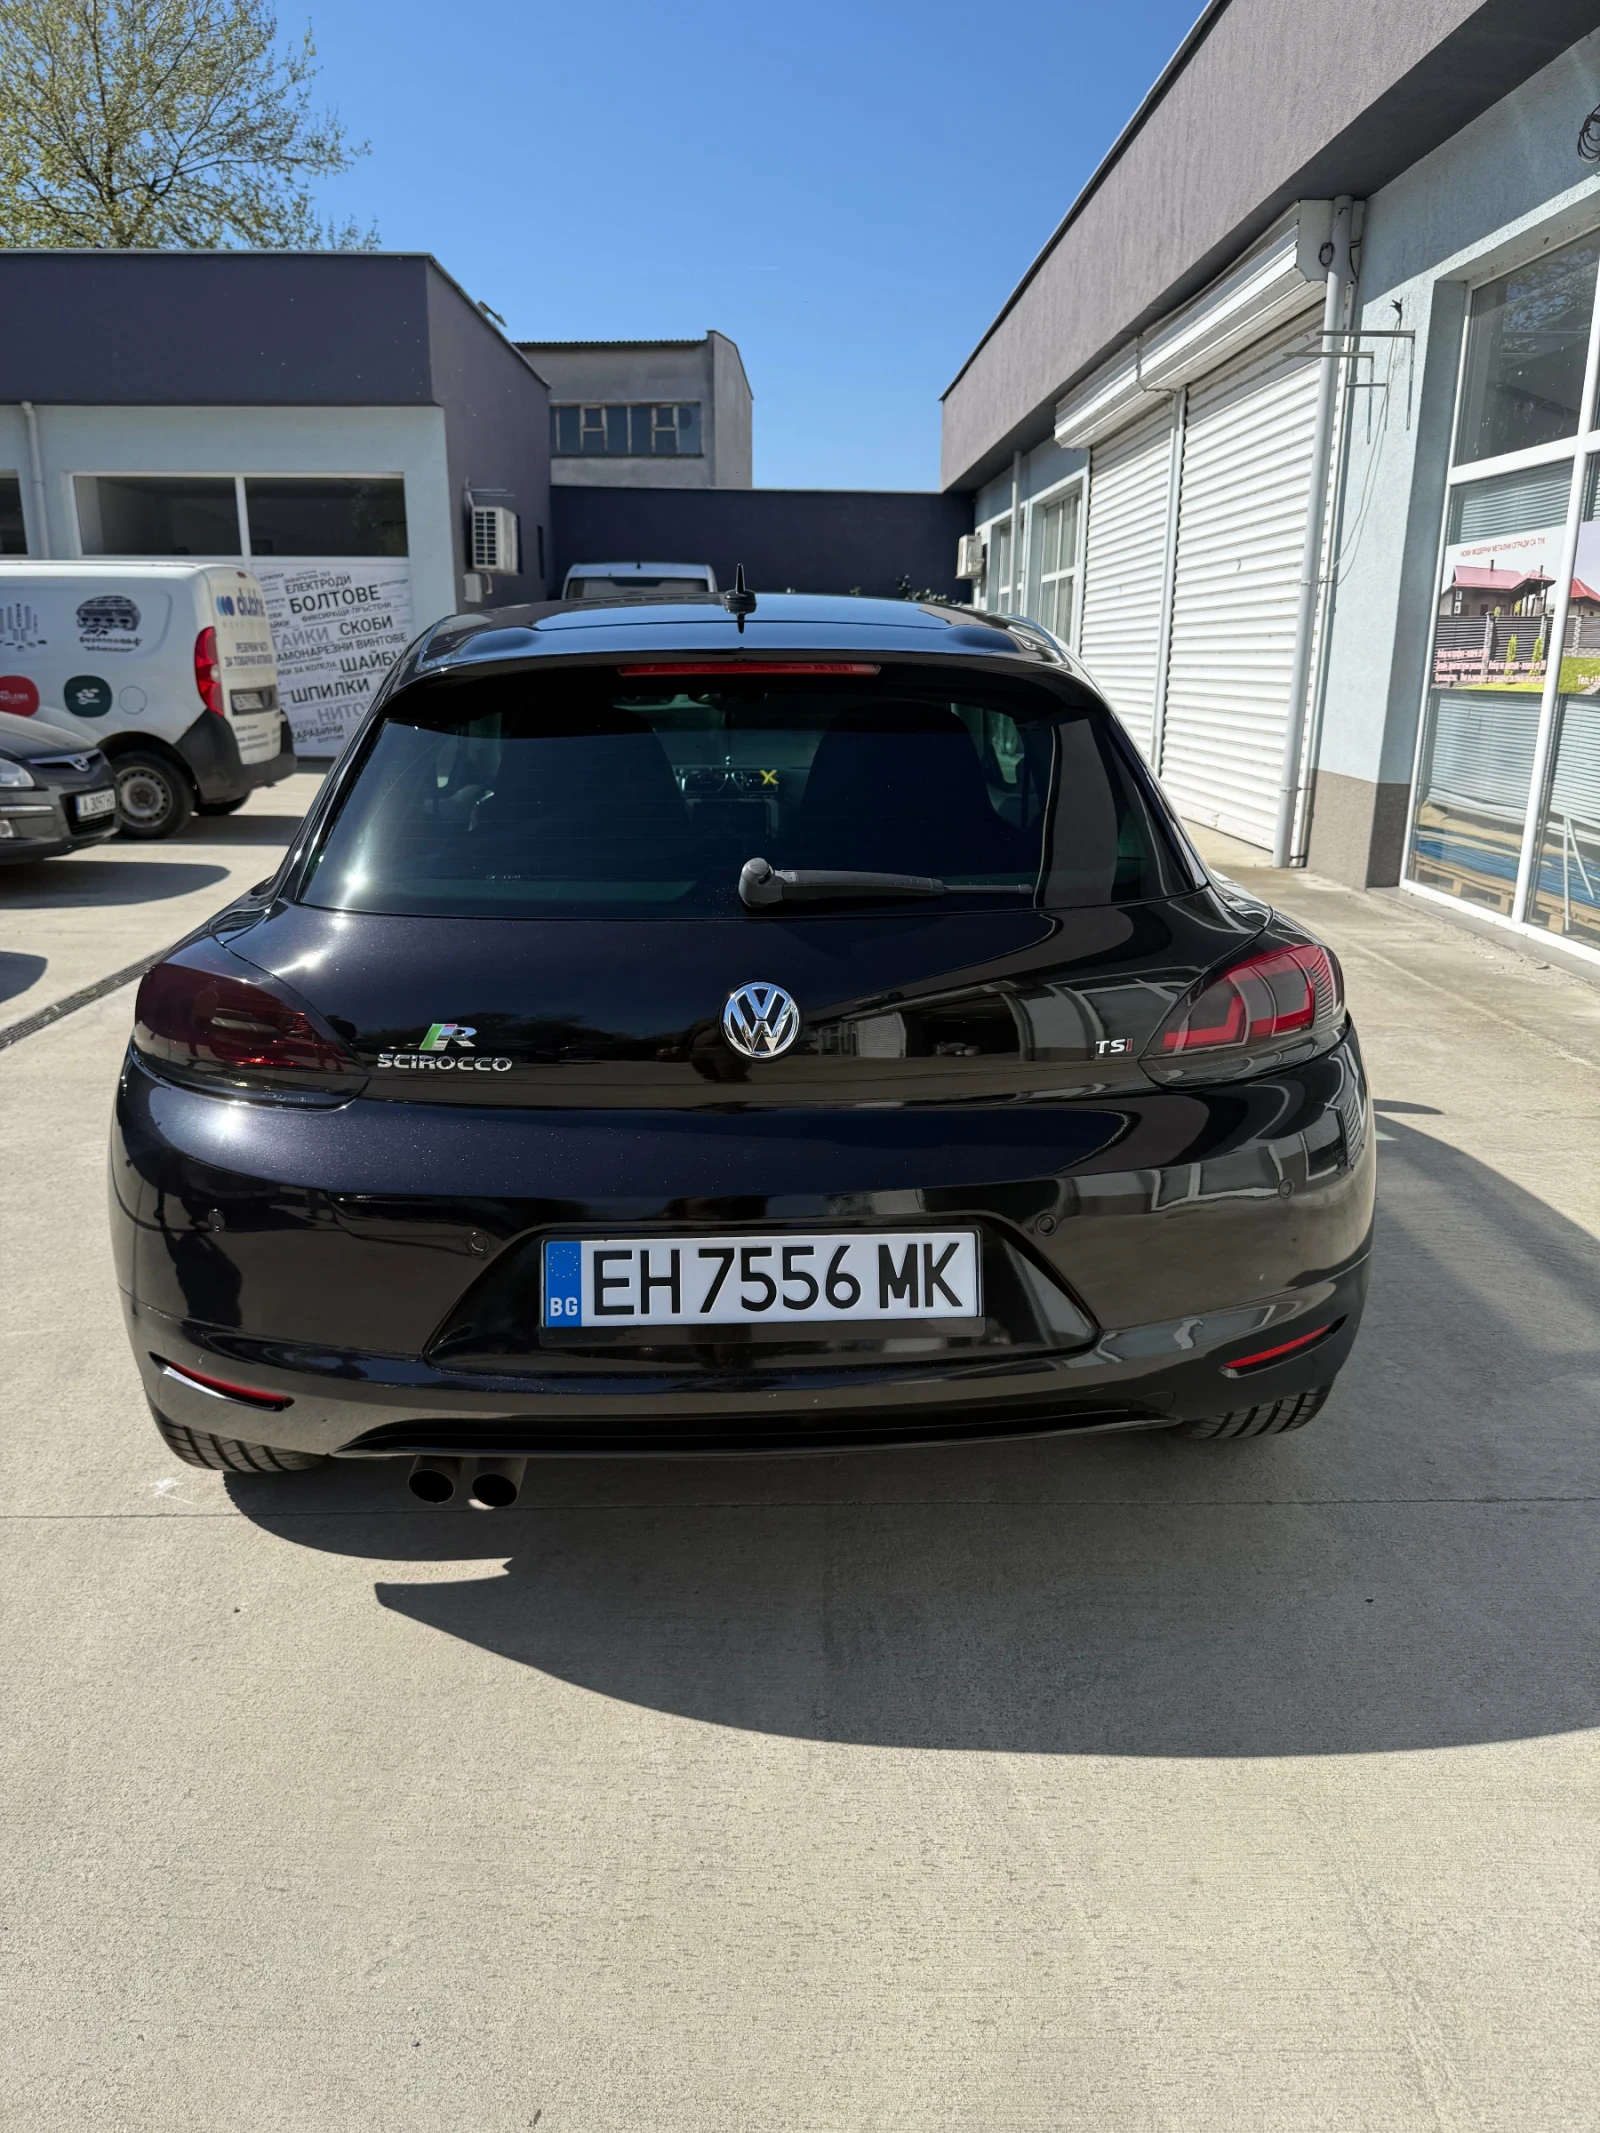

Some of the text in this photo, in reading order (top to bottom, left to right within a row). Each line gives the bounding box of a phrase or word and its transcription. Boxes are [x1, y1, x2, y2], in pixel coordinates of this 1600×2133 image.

[284, 575, 352, 594] ЕЛЕКТРОДИ
[289, 584, 382, 614] БОЛТОВЕ
[339, 615, 393, 636] СКОБИ
[271, 626, 330, 650] ГАЙКИ
[276, 640, 354, 663] АМОНАРЕЗНИ
[355, 632, 408, 650] ВИНТОВЕ
[340, 650, 400, 674] ШАЙБ
[290, 678, 370, 704] ШПИЛКИ
[317, 701, 368, 724] НИТО
[419, 1023, 477, 1051] R
[1095, 1038, 1133, 1054] TSI
[377, 1053, 513, 1072] SCIROCCO
[593, 1242, 964, 1315] EH 7556 MK
[550, 1297, 579, 1317] BG
